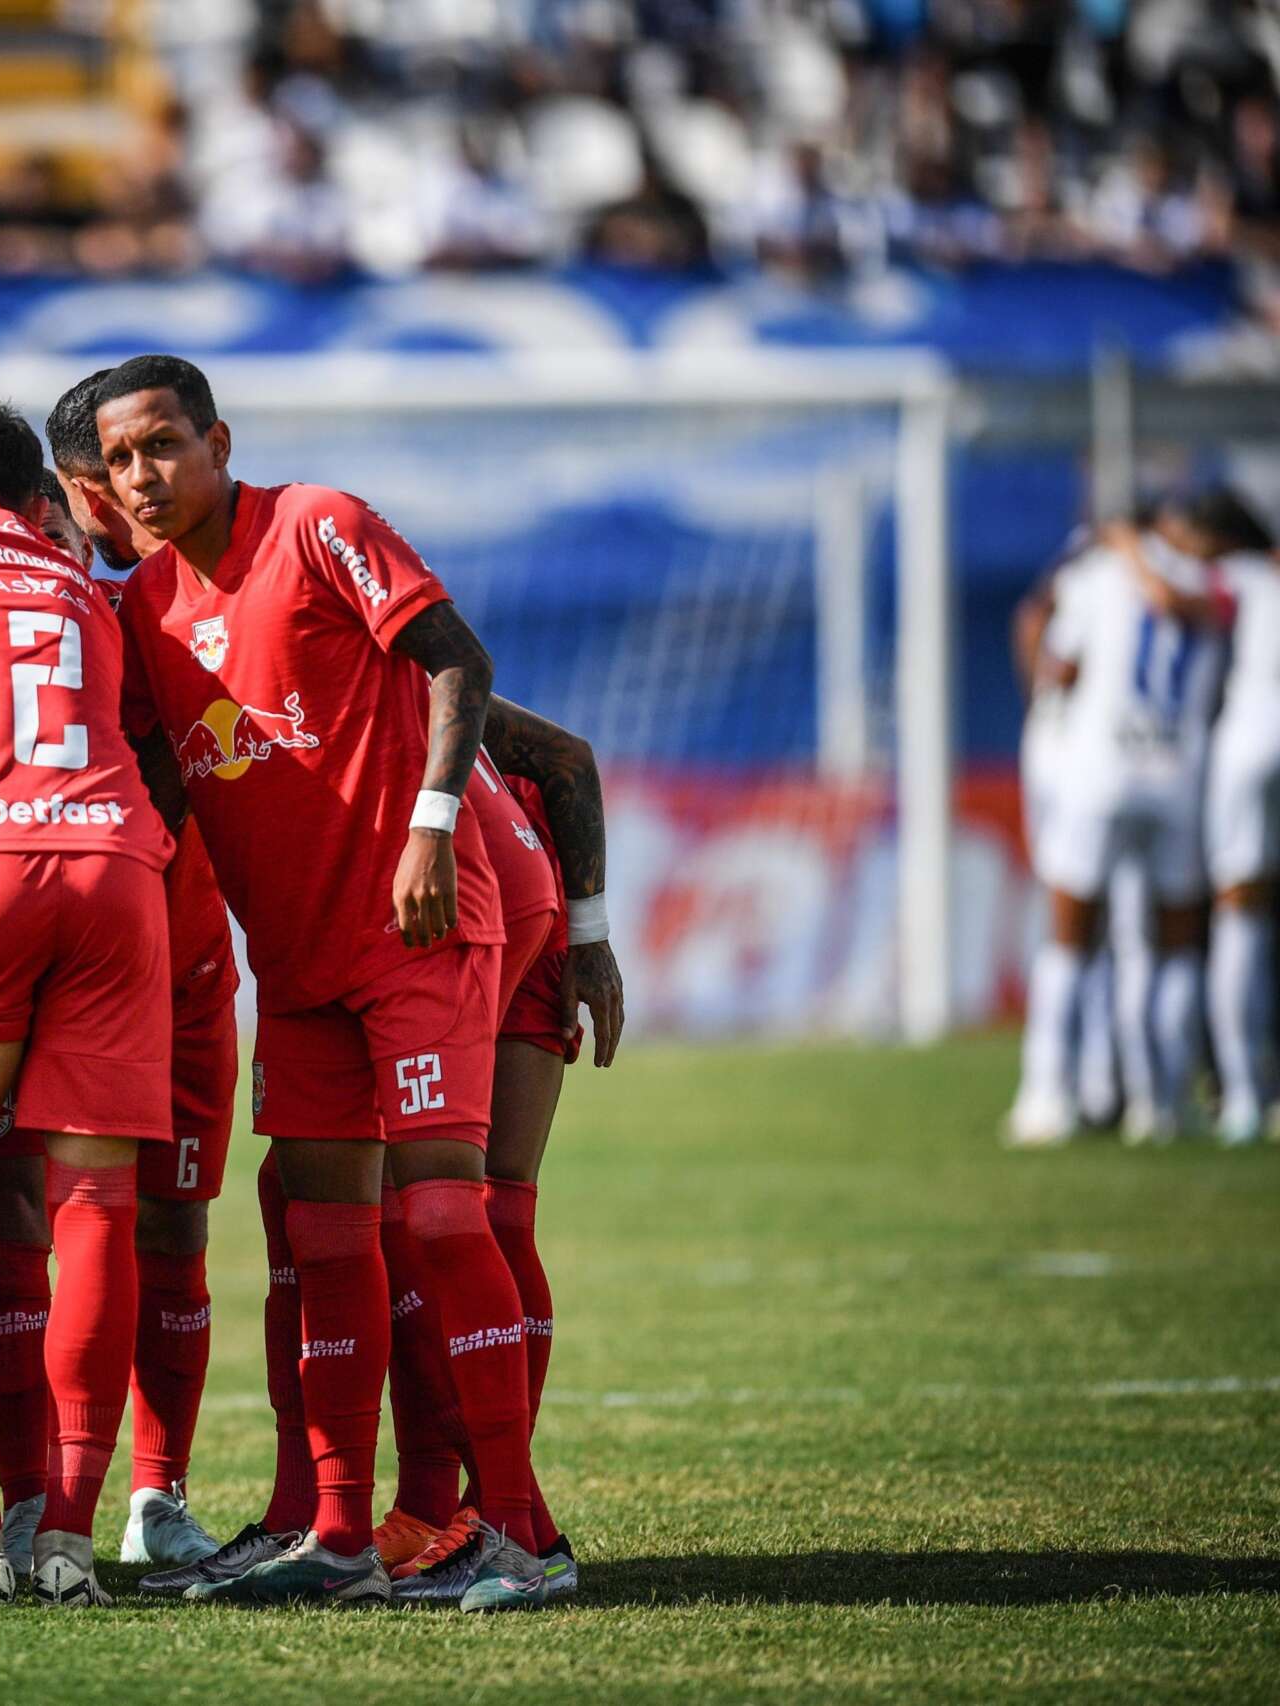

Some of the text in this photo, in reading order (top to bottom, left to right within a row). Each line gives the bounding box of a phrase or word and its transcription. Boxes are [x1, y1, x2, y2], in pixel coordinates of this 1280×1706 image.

[317, 515, 388, 608] betfast
[8, 610, 89, 770] 2
[396, 1053, 445, 1116] 52
[14, 1311, 48, 1323] Bull
[486, 1323, 522, 1338] Bull
[313, 1339, 356, 1350] Bull
